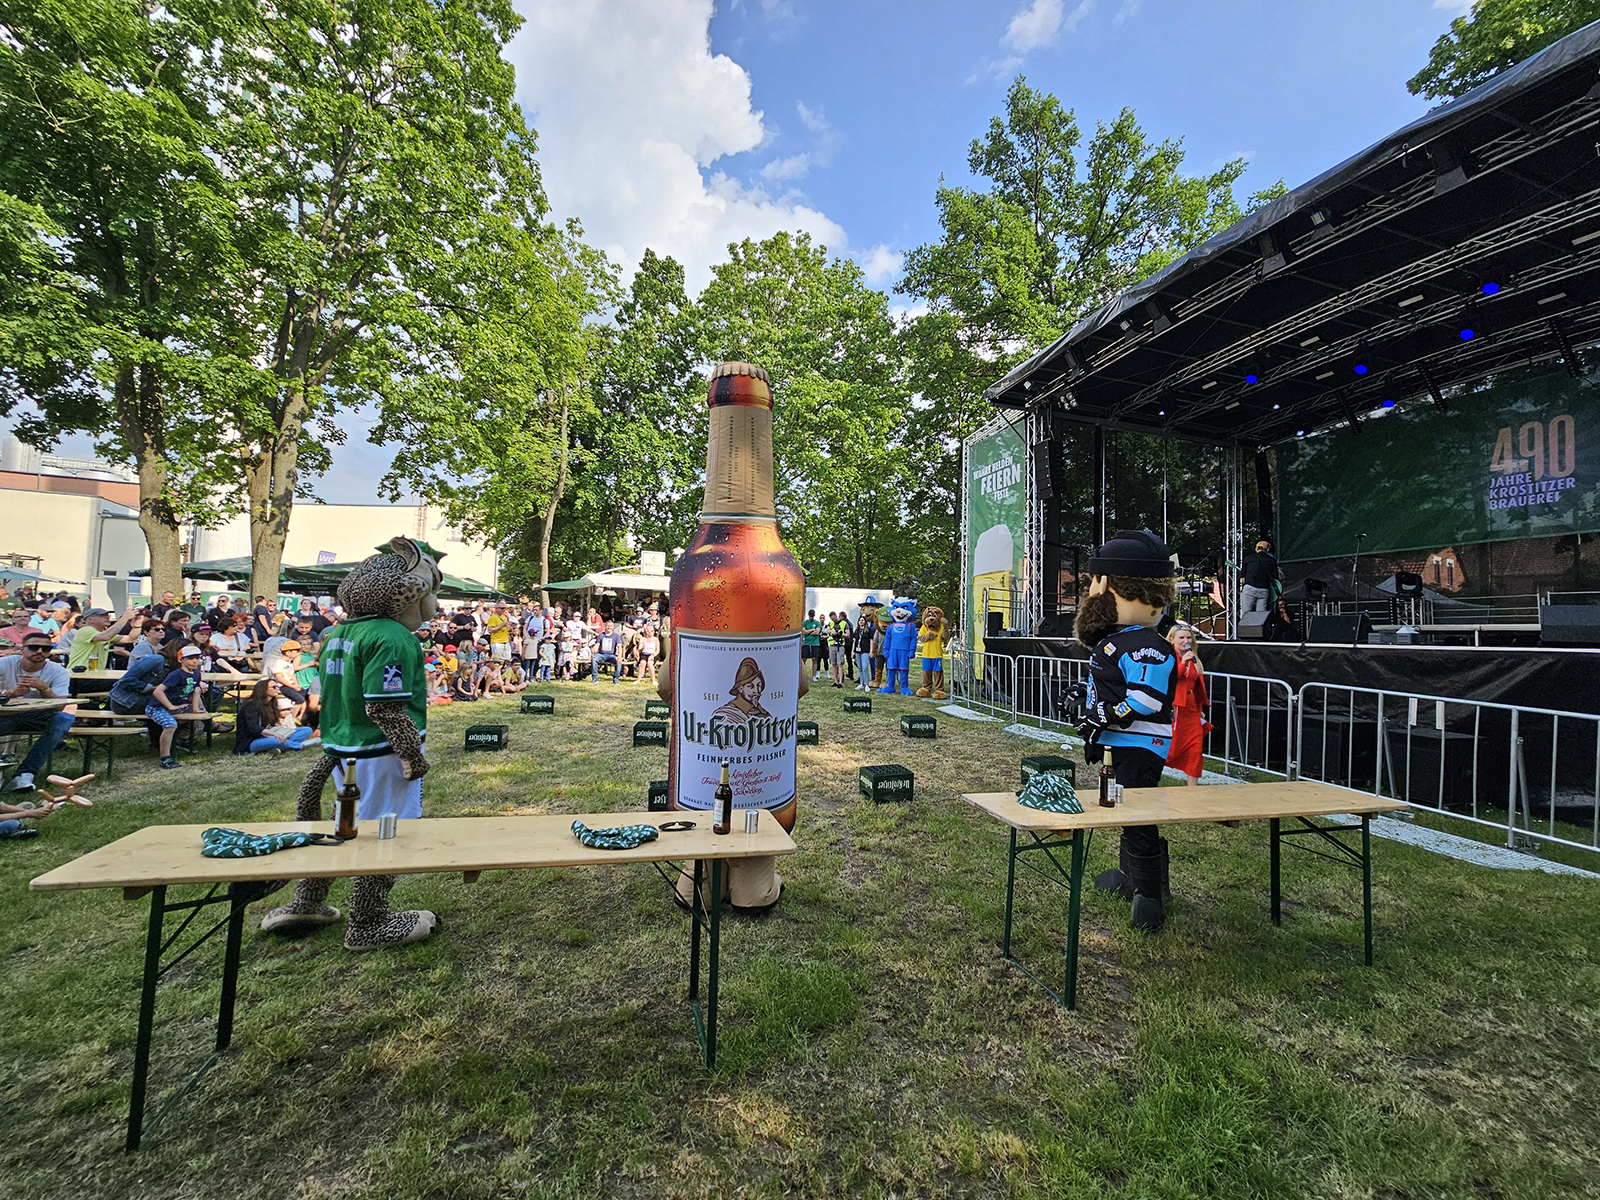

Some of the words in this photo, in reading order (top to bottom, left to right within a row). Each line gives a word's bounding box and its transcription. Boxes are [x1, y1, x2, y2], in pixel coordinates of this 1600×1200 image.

[1490, 414, 1575, 481] 490
[992, 455, 1013, 473] HELDEN
[981, 463, 1021, 496] FEIERN
[1490, 472, 1532, 489] JAHRE
[1490, 477, 1576, 499] KROSTITZER
[994, 487, 1009, 501] FESTE
[1490, 491, 1561, 510] BRAUEREI
[320, 554, 335, 564] WC
[1139, 664, 1148, 682] 1
[703, 692, 719, 701] SEIT
[770, 691, 784, 700] 1534
[697, 753, 753, 765] FEINHERBES
[757, 749, 787, 763] PILSNER
